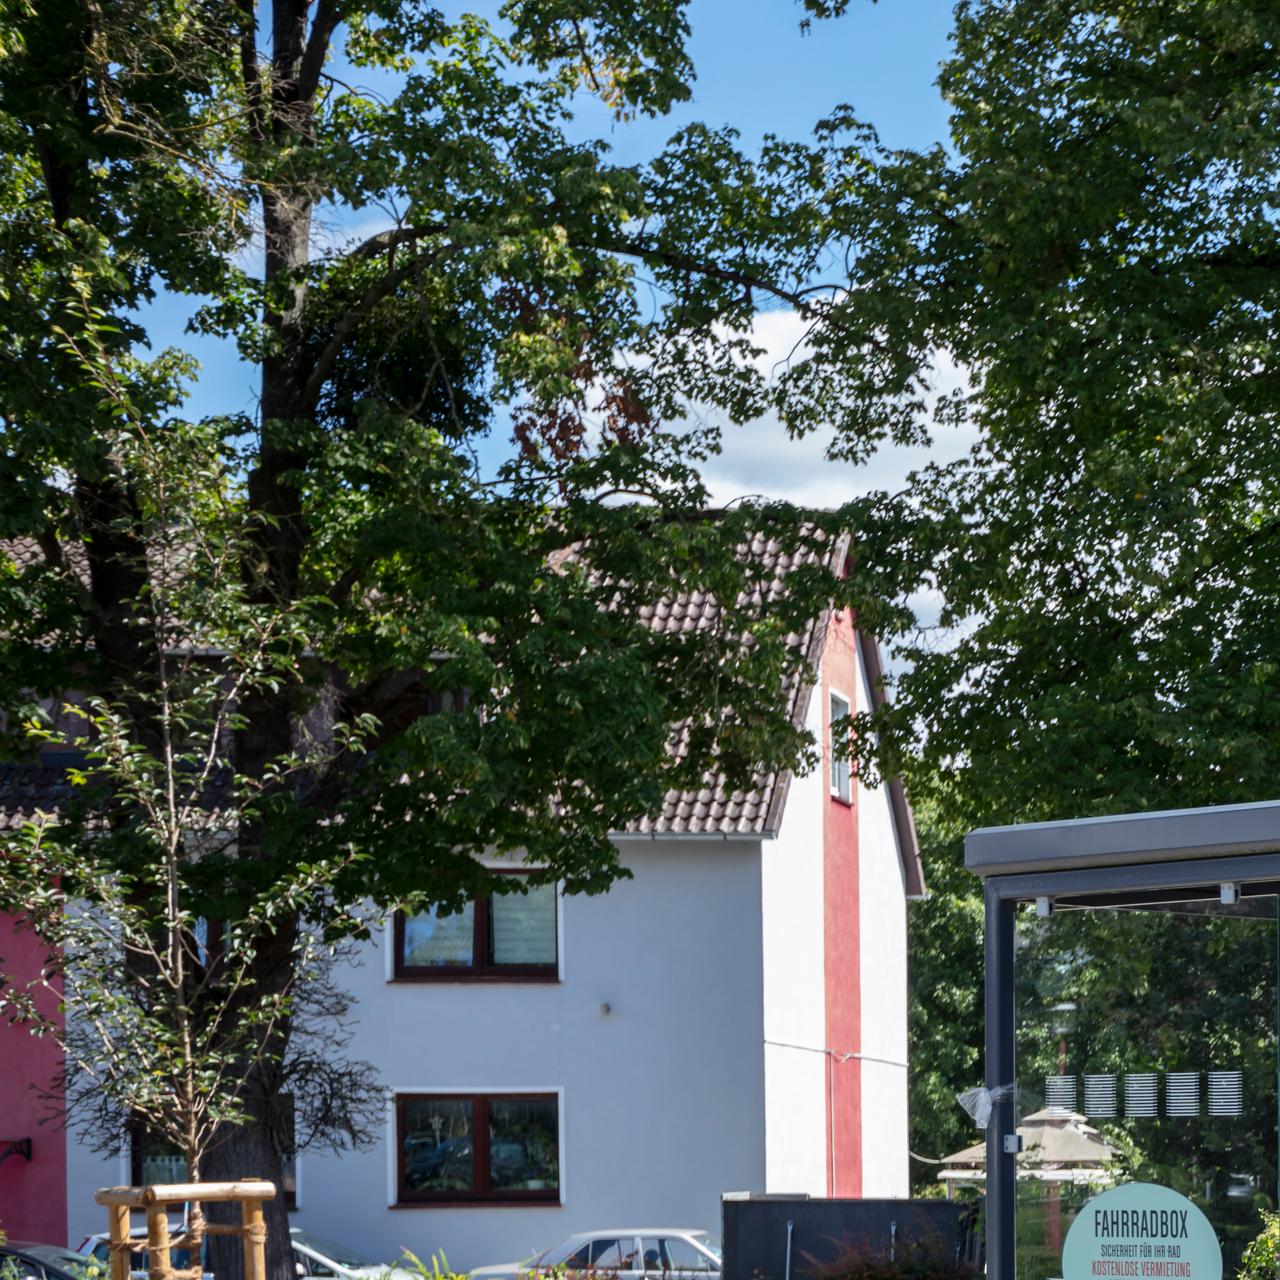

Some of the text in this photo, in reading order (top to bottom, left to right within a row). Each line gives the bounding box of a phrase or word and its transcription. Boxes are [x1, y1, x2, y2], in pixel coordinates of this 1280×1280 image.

[1095, 1209, 1189, 1239] FAHRRADBOX
[1100, 1242, 1181, 1259] SICHERHEIT FÜR IHR RAD
[1092, 1260, 1191, 1278] KOSTENLOSE VERMIETUNG
